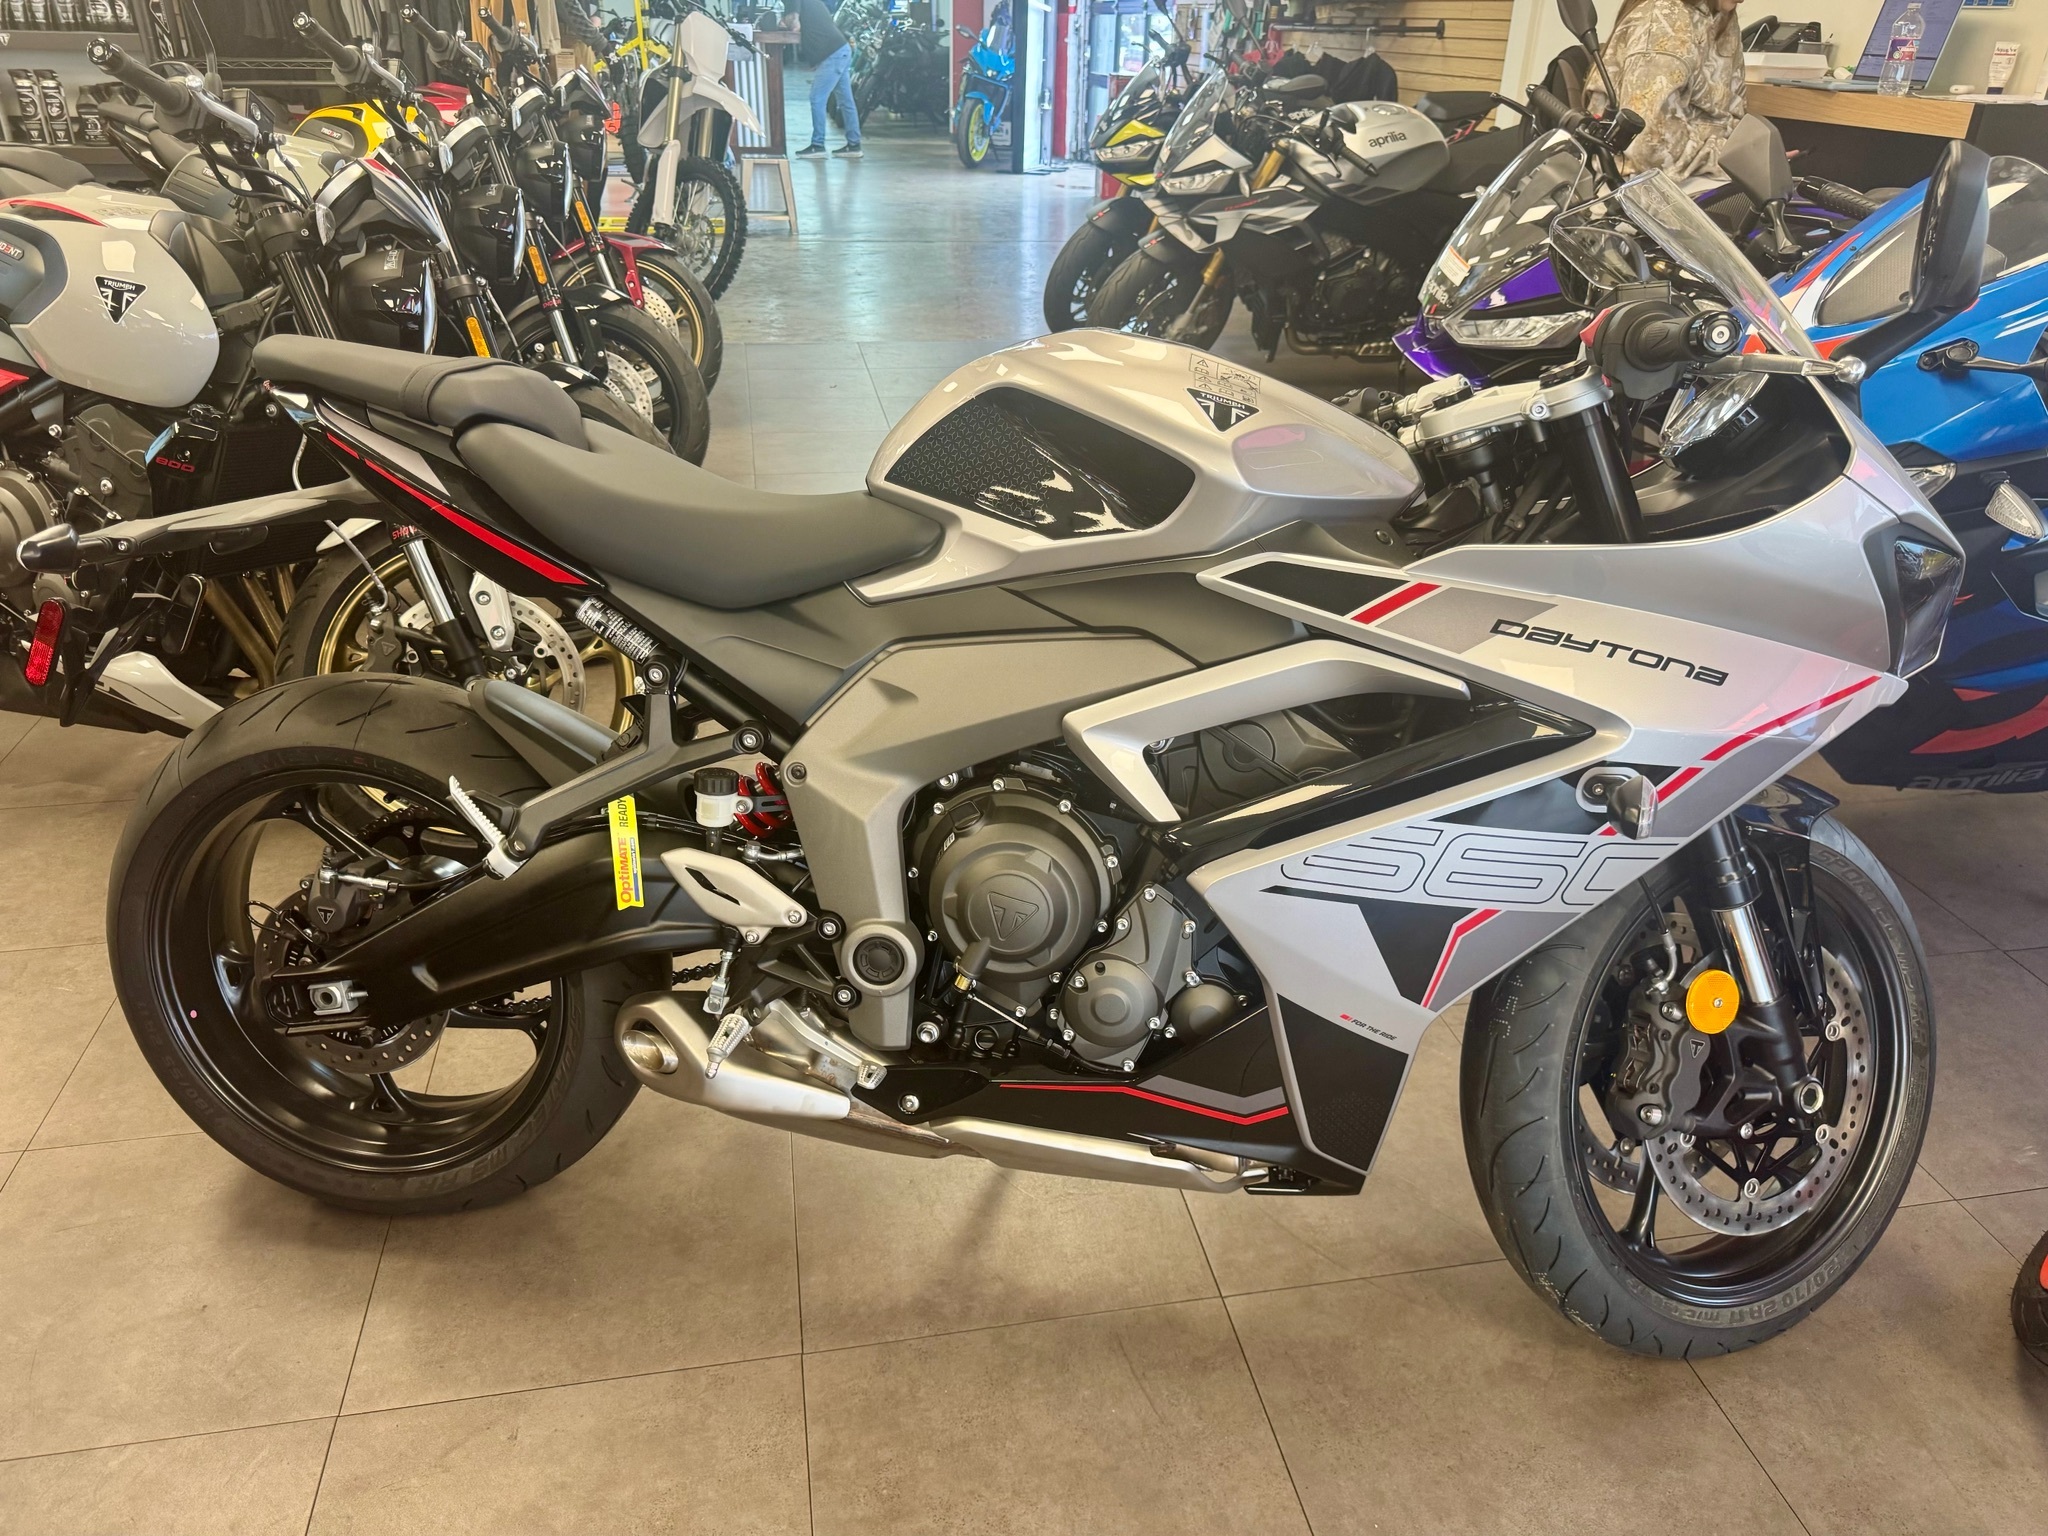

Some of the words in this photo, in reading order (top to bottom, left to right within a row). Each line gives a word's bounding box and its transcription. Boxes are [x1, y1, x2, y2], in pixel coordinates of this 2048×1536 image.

[1368, 131, 1407, 148] aprilia
[103, 279, 136, 291] TRIUMPH
[1200, 392, 1246, 410] TRIUMPH
[155, 456, 195, 473] 800
[617, 798, 629, 828] READY
[618, 837, 633, 903] OptiMATE
[1350, 1018, 1367, 1028] FOR
[1366, 1025, 1381, 1034] THE
[1379, 1031, 1398, 1041] RIDE
